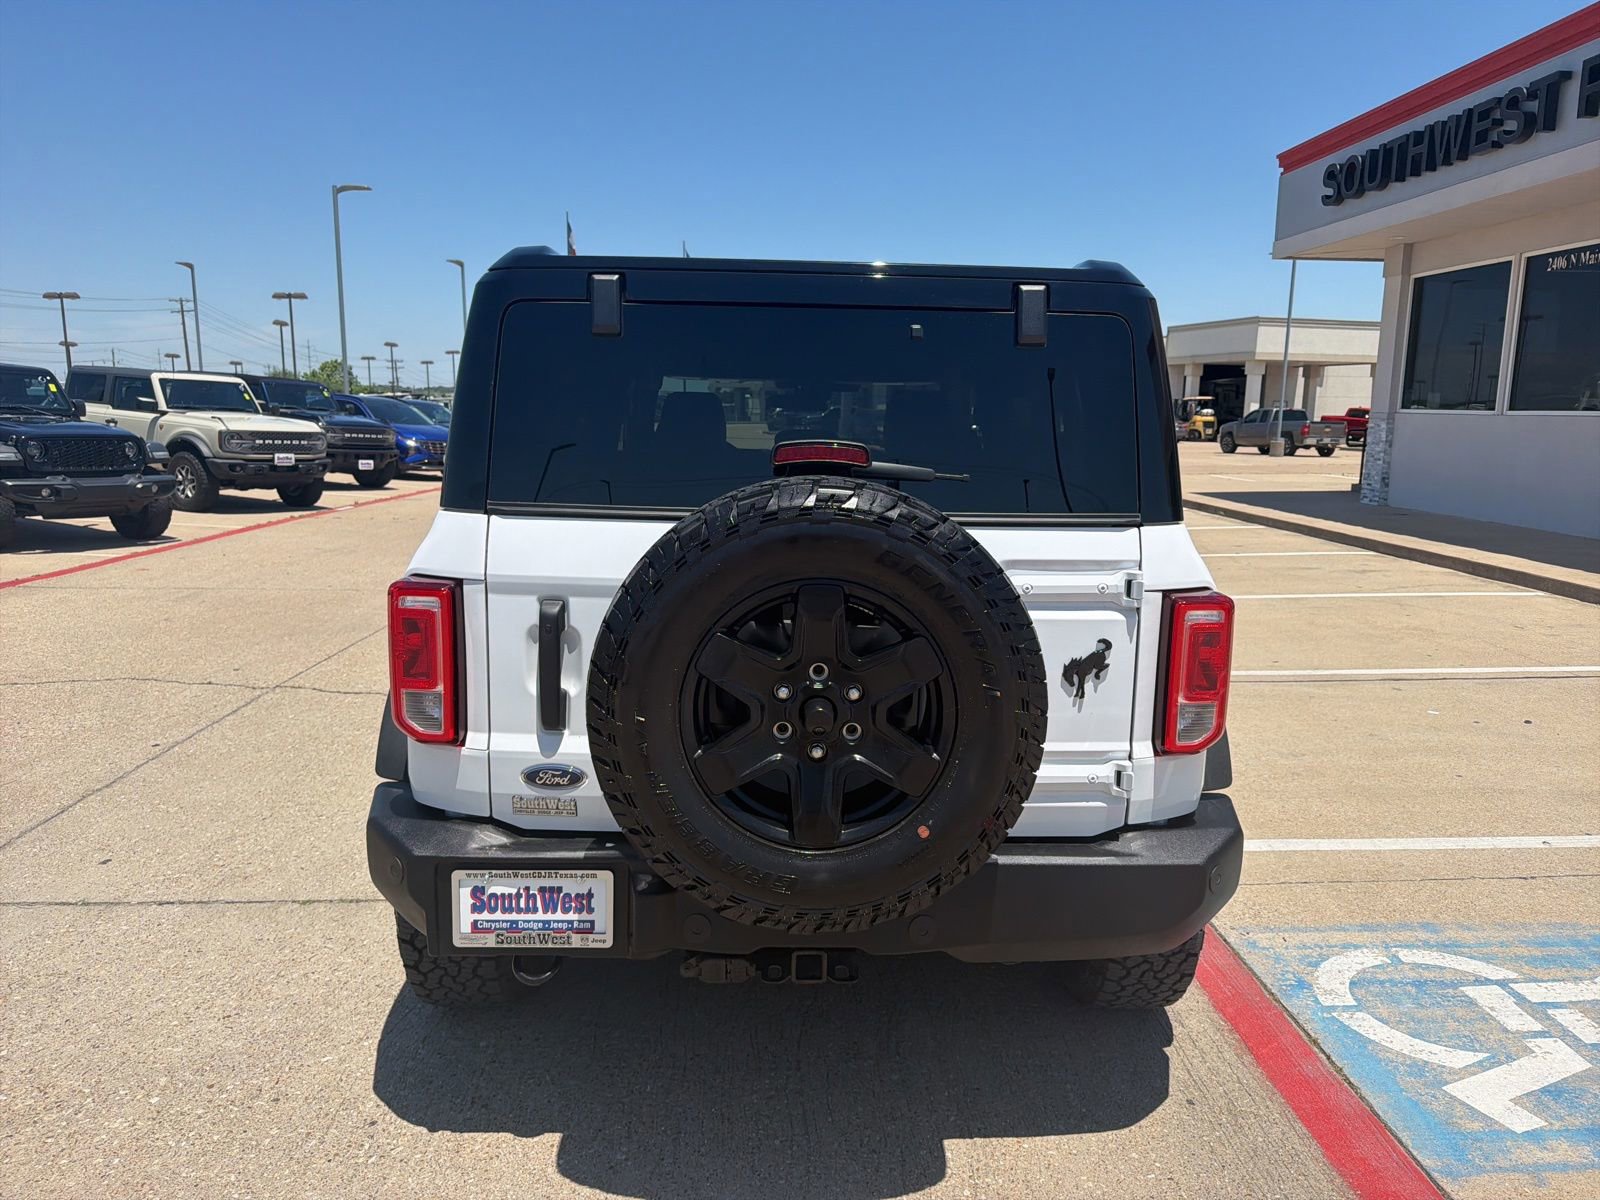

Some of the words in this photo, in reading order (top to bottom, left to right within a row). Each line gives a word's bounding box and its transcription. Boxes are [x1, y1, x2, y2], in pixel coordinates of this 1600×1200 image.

[1321, 70, 1573, 206] SOUTHWEST
[1546, 255, 1567, 271] 2406
[1569, 253, 1577, 268] N
[535, 769, 571, 785] Ford
[512, 796, 577, 810] SouthWest
[465, 871, 598, 879] www.SouthWestCDJRTexas.com
[470, 885, 595, 915] SouthWest
[477, 920, 511, 930] Chrysler
[518, 920, 543, 930] Dodge
[549, 920, 568, 930] Jeep
[573, 920, 591, 929] Ram
[495, 933, 573, 946] SouthWest
